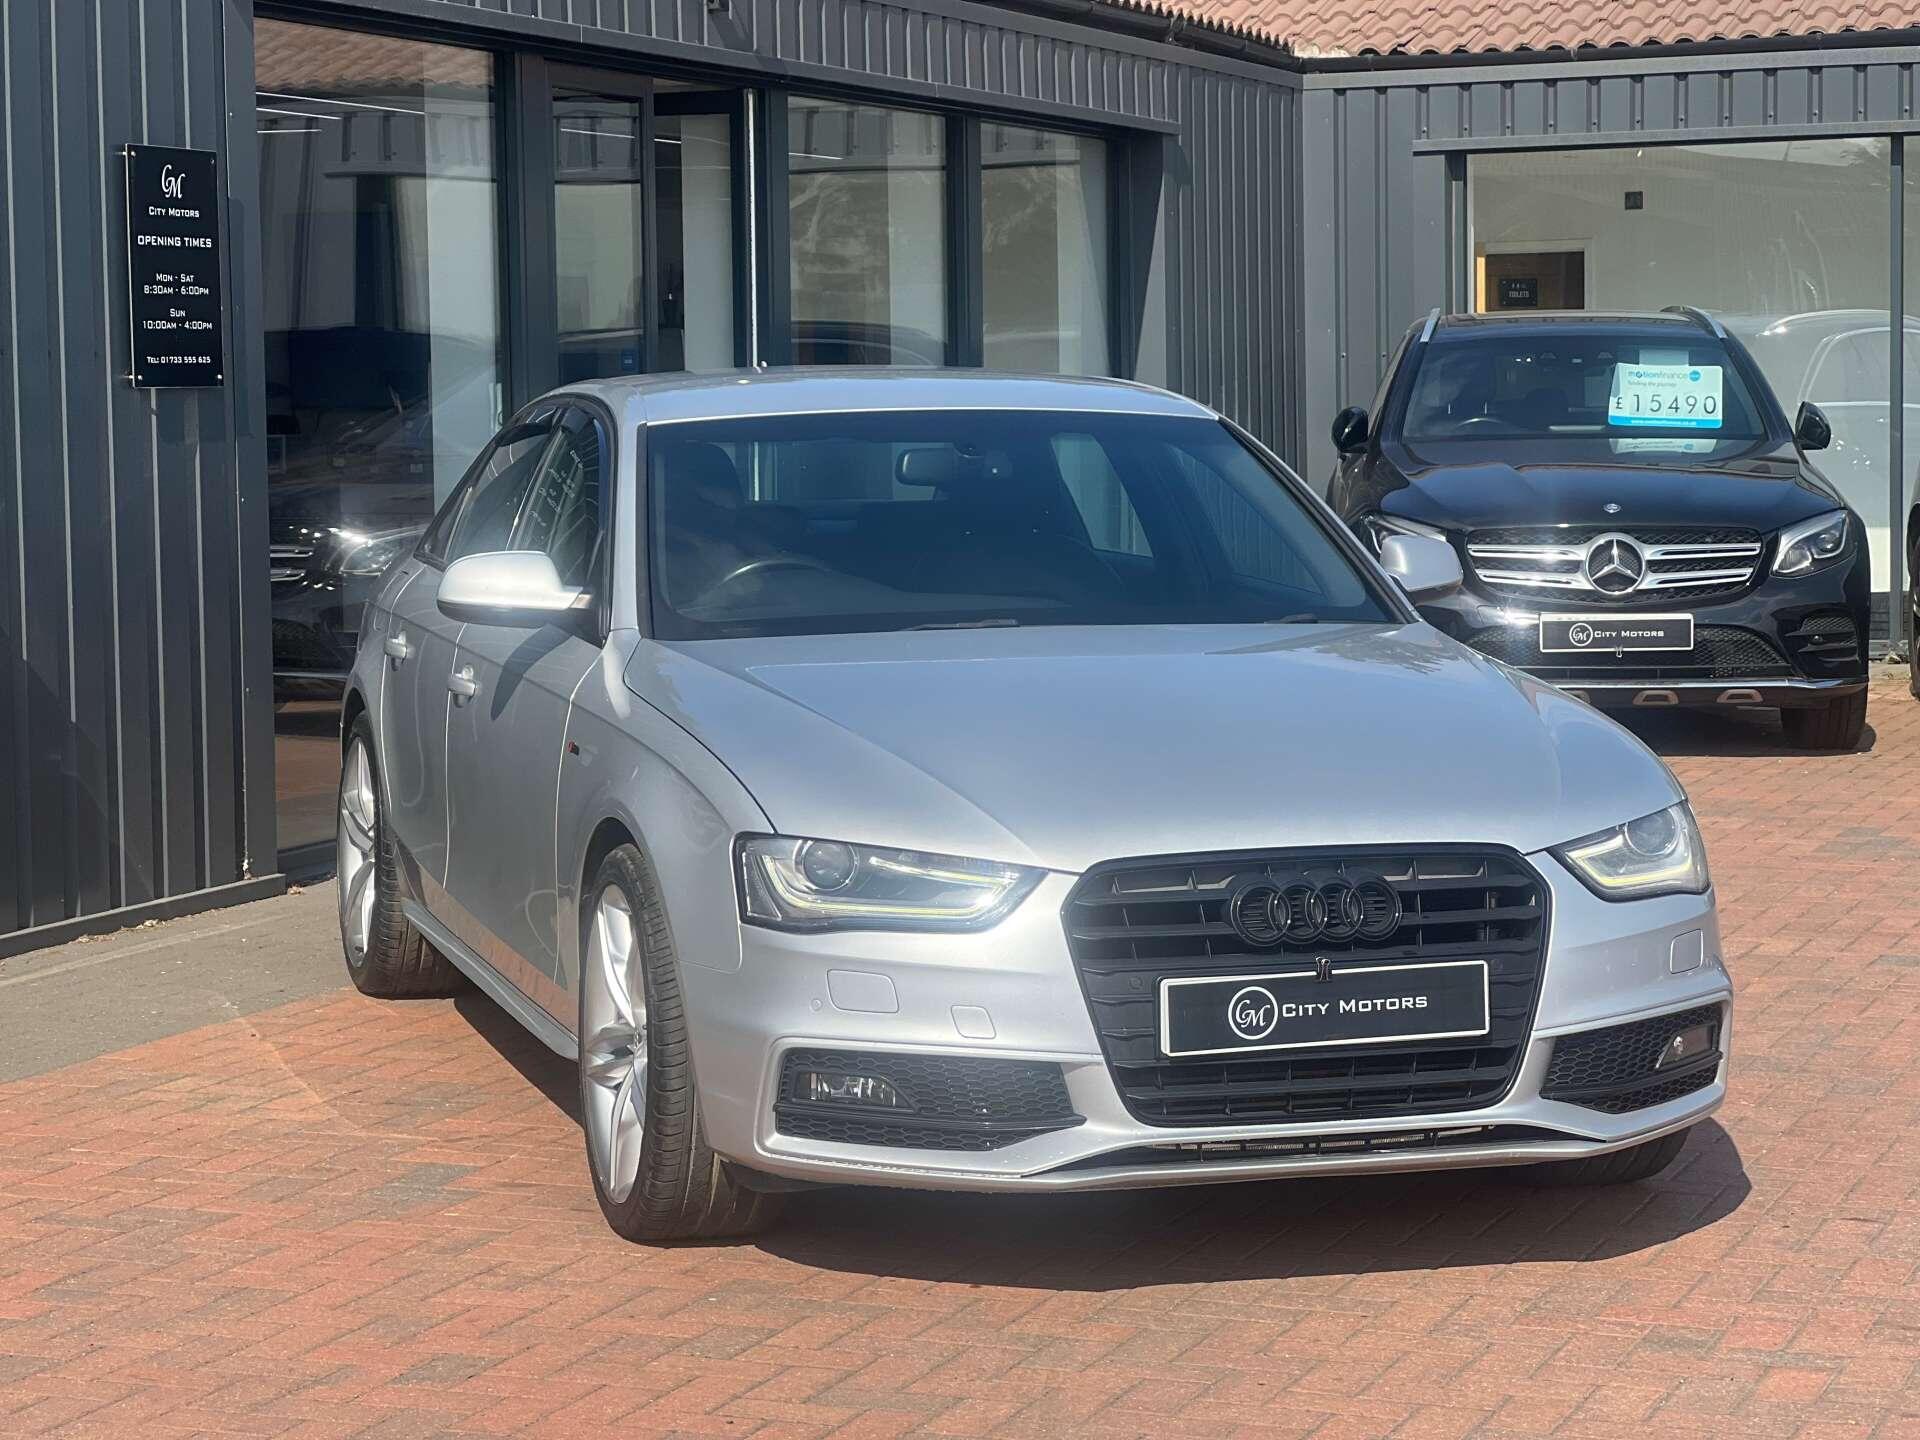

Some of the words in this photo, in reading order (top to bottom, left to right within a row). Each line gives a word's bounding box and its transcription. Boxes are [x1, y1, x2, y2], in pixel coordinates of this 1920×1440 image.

[148, 206, 166, 216] CITY
[168, 207, 200, 218] MOTORS
[137, 235, 181, 247] OPENING
[183, 237, 212, 248] TIMES
[156, 273, 173, 282] MON
[180, 273, 194, 283] SAT
[143, 285, 174, 294] 8:30AM
[180, 286, 209, 295] 6:00PM
[169, 308, 186, 317] SUN
[143, 320, 177, 329] 10:00AM
[184, 321, 213, 330] 4:00PM
[160, 356, 182, 364] 01733
[184, 356, 197, 364] 555
[198, 356, 211, 364] 625
[1621, 630, 1665, 638] MOTORS
[1282, 1002, 1330, 1018] CITY
[1339, 996, 1428, 1014] MOTORS
